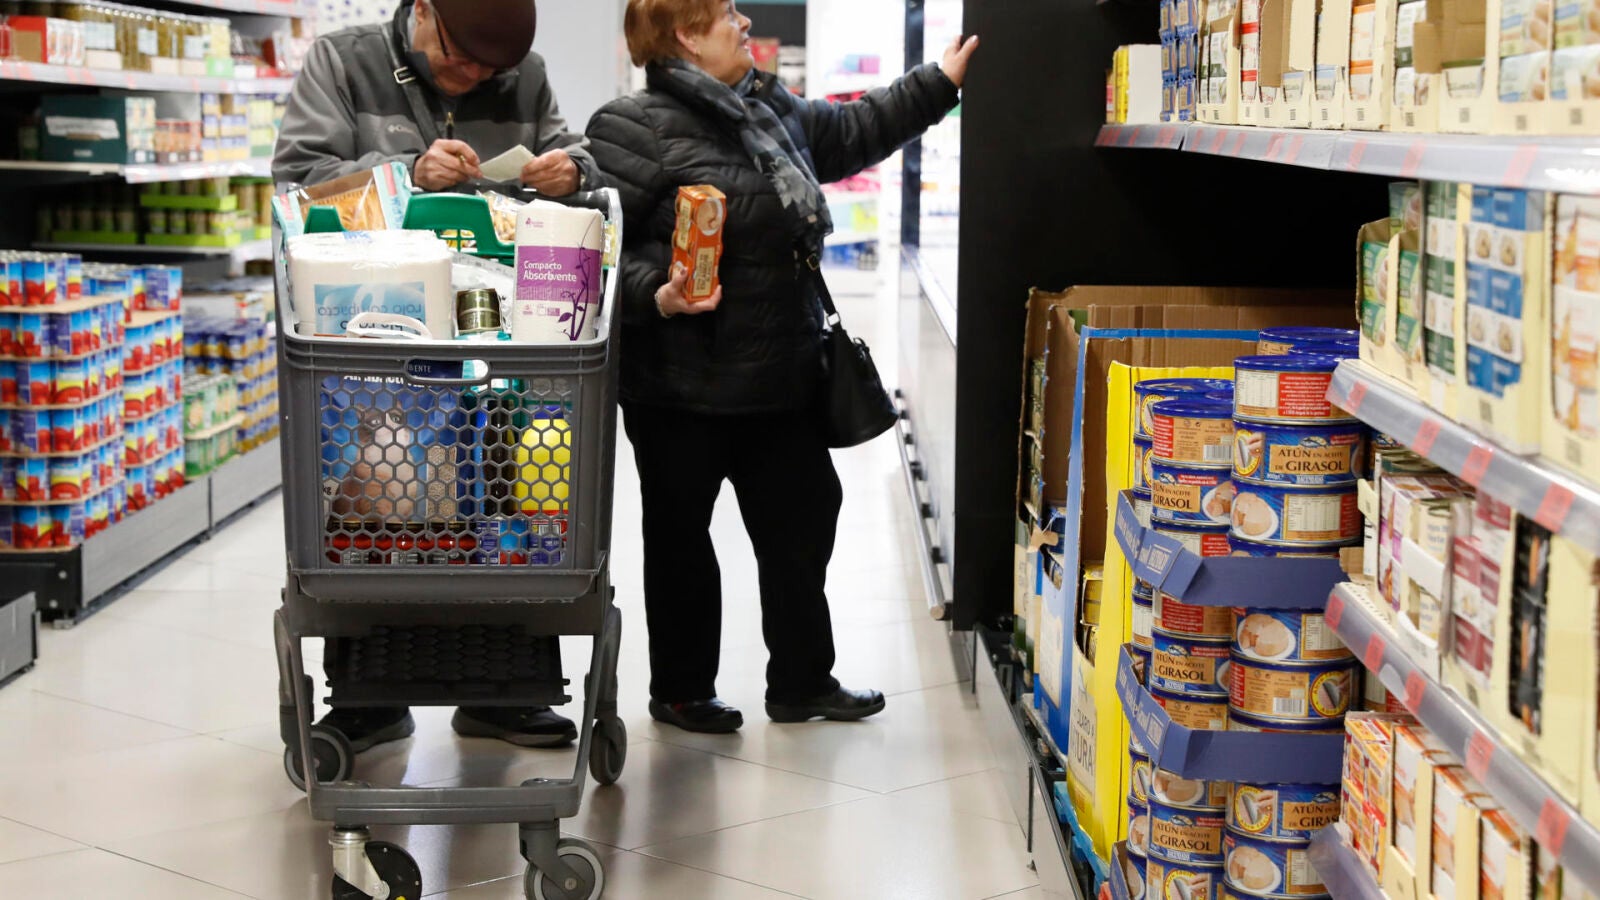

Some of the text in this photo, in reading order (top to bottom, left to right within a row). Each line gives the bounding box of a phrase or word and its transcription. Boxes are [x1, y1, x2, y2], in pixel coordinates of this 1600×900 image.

[523, 260, 562, 270] Compacto
[1278, 447, 1311, 458] ATÚN
[1285, 460, 1345, 472] GIRASOL
[1153, 494, 1193, 510] GIRASOL
[1158, 664, 1207, 682] GIRASOL
[1292, 804, 1323, 814] ATÚN
[1160, 834, 1213, 851] GIRASOL
